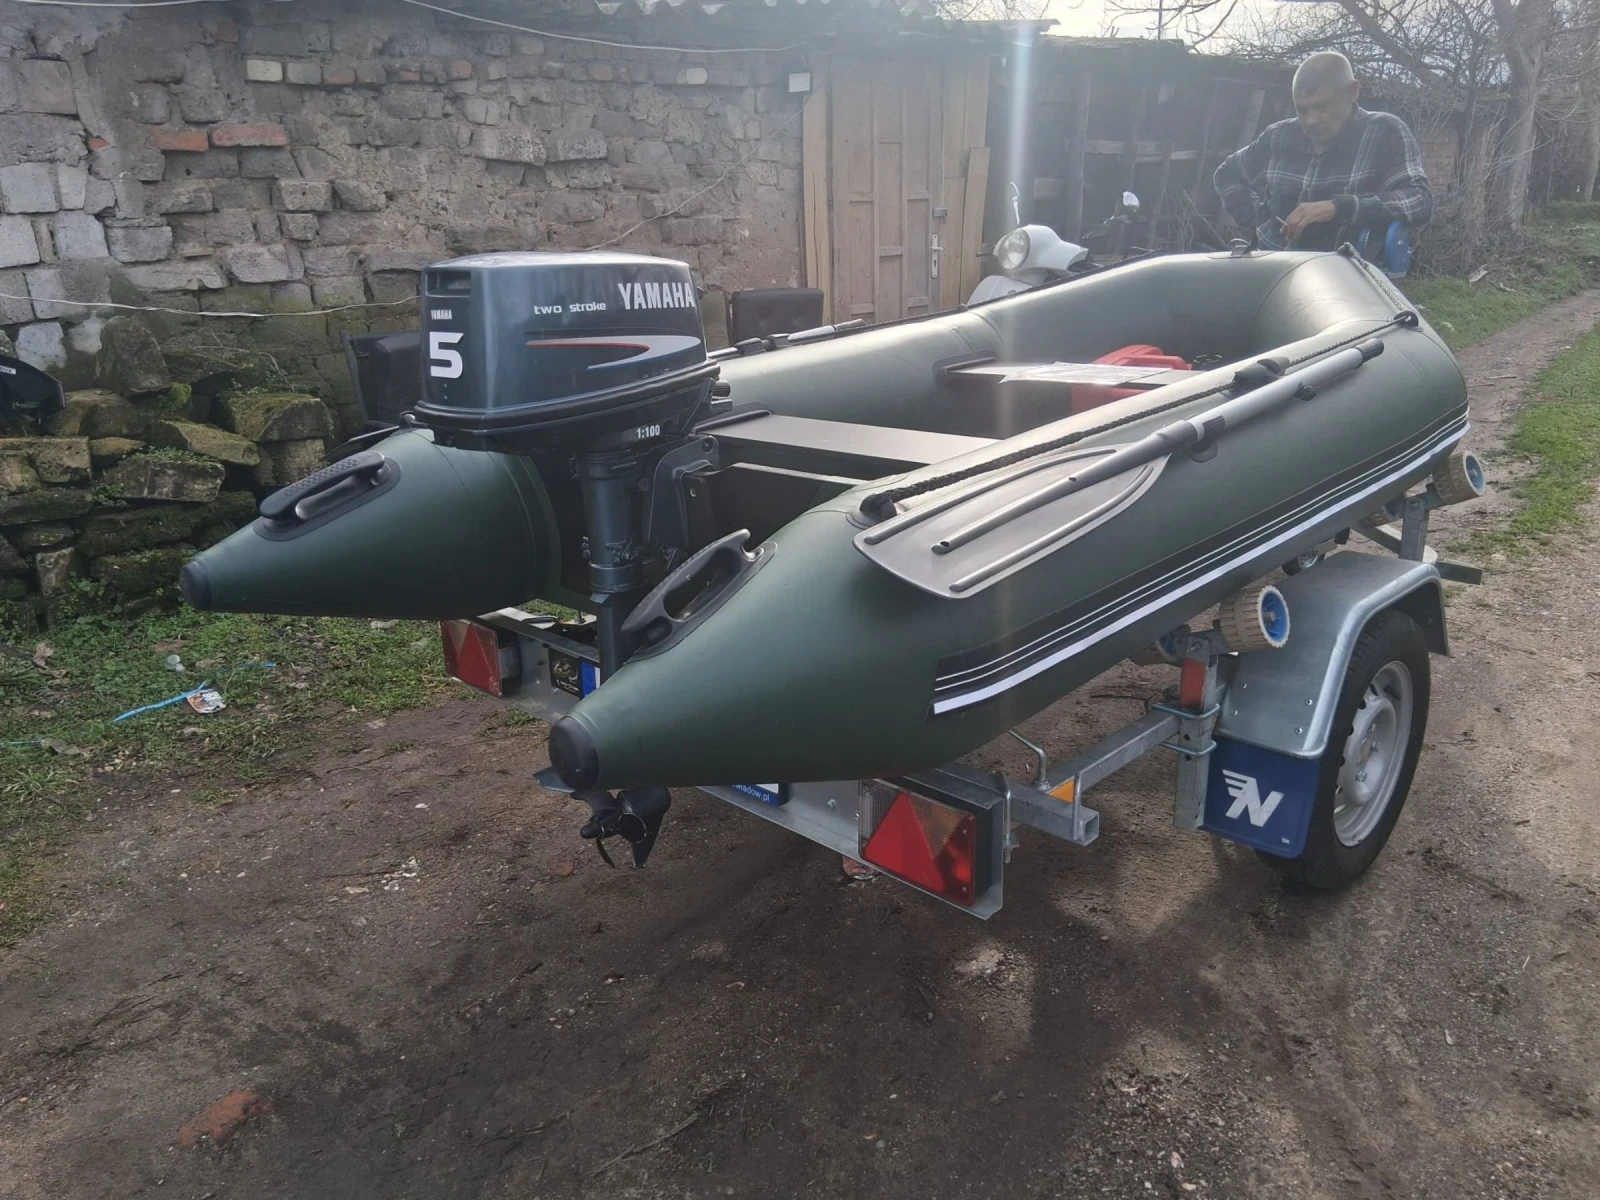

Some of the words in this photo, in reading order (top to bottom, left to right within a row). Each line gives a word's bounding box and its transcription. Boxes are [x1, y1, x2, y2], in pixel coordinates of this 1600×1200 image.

[617, 282, 696, 310] YAMAHA
[430, 309, 453, 320] YAMAHA
[533, 305, 563, 315] two
[569, 301, 607, 313] stroke
[429, 331, 464, 379] 5
[637, 424, 660, 439] 1:100
